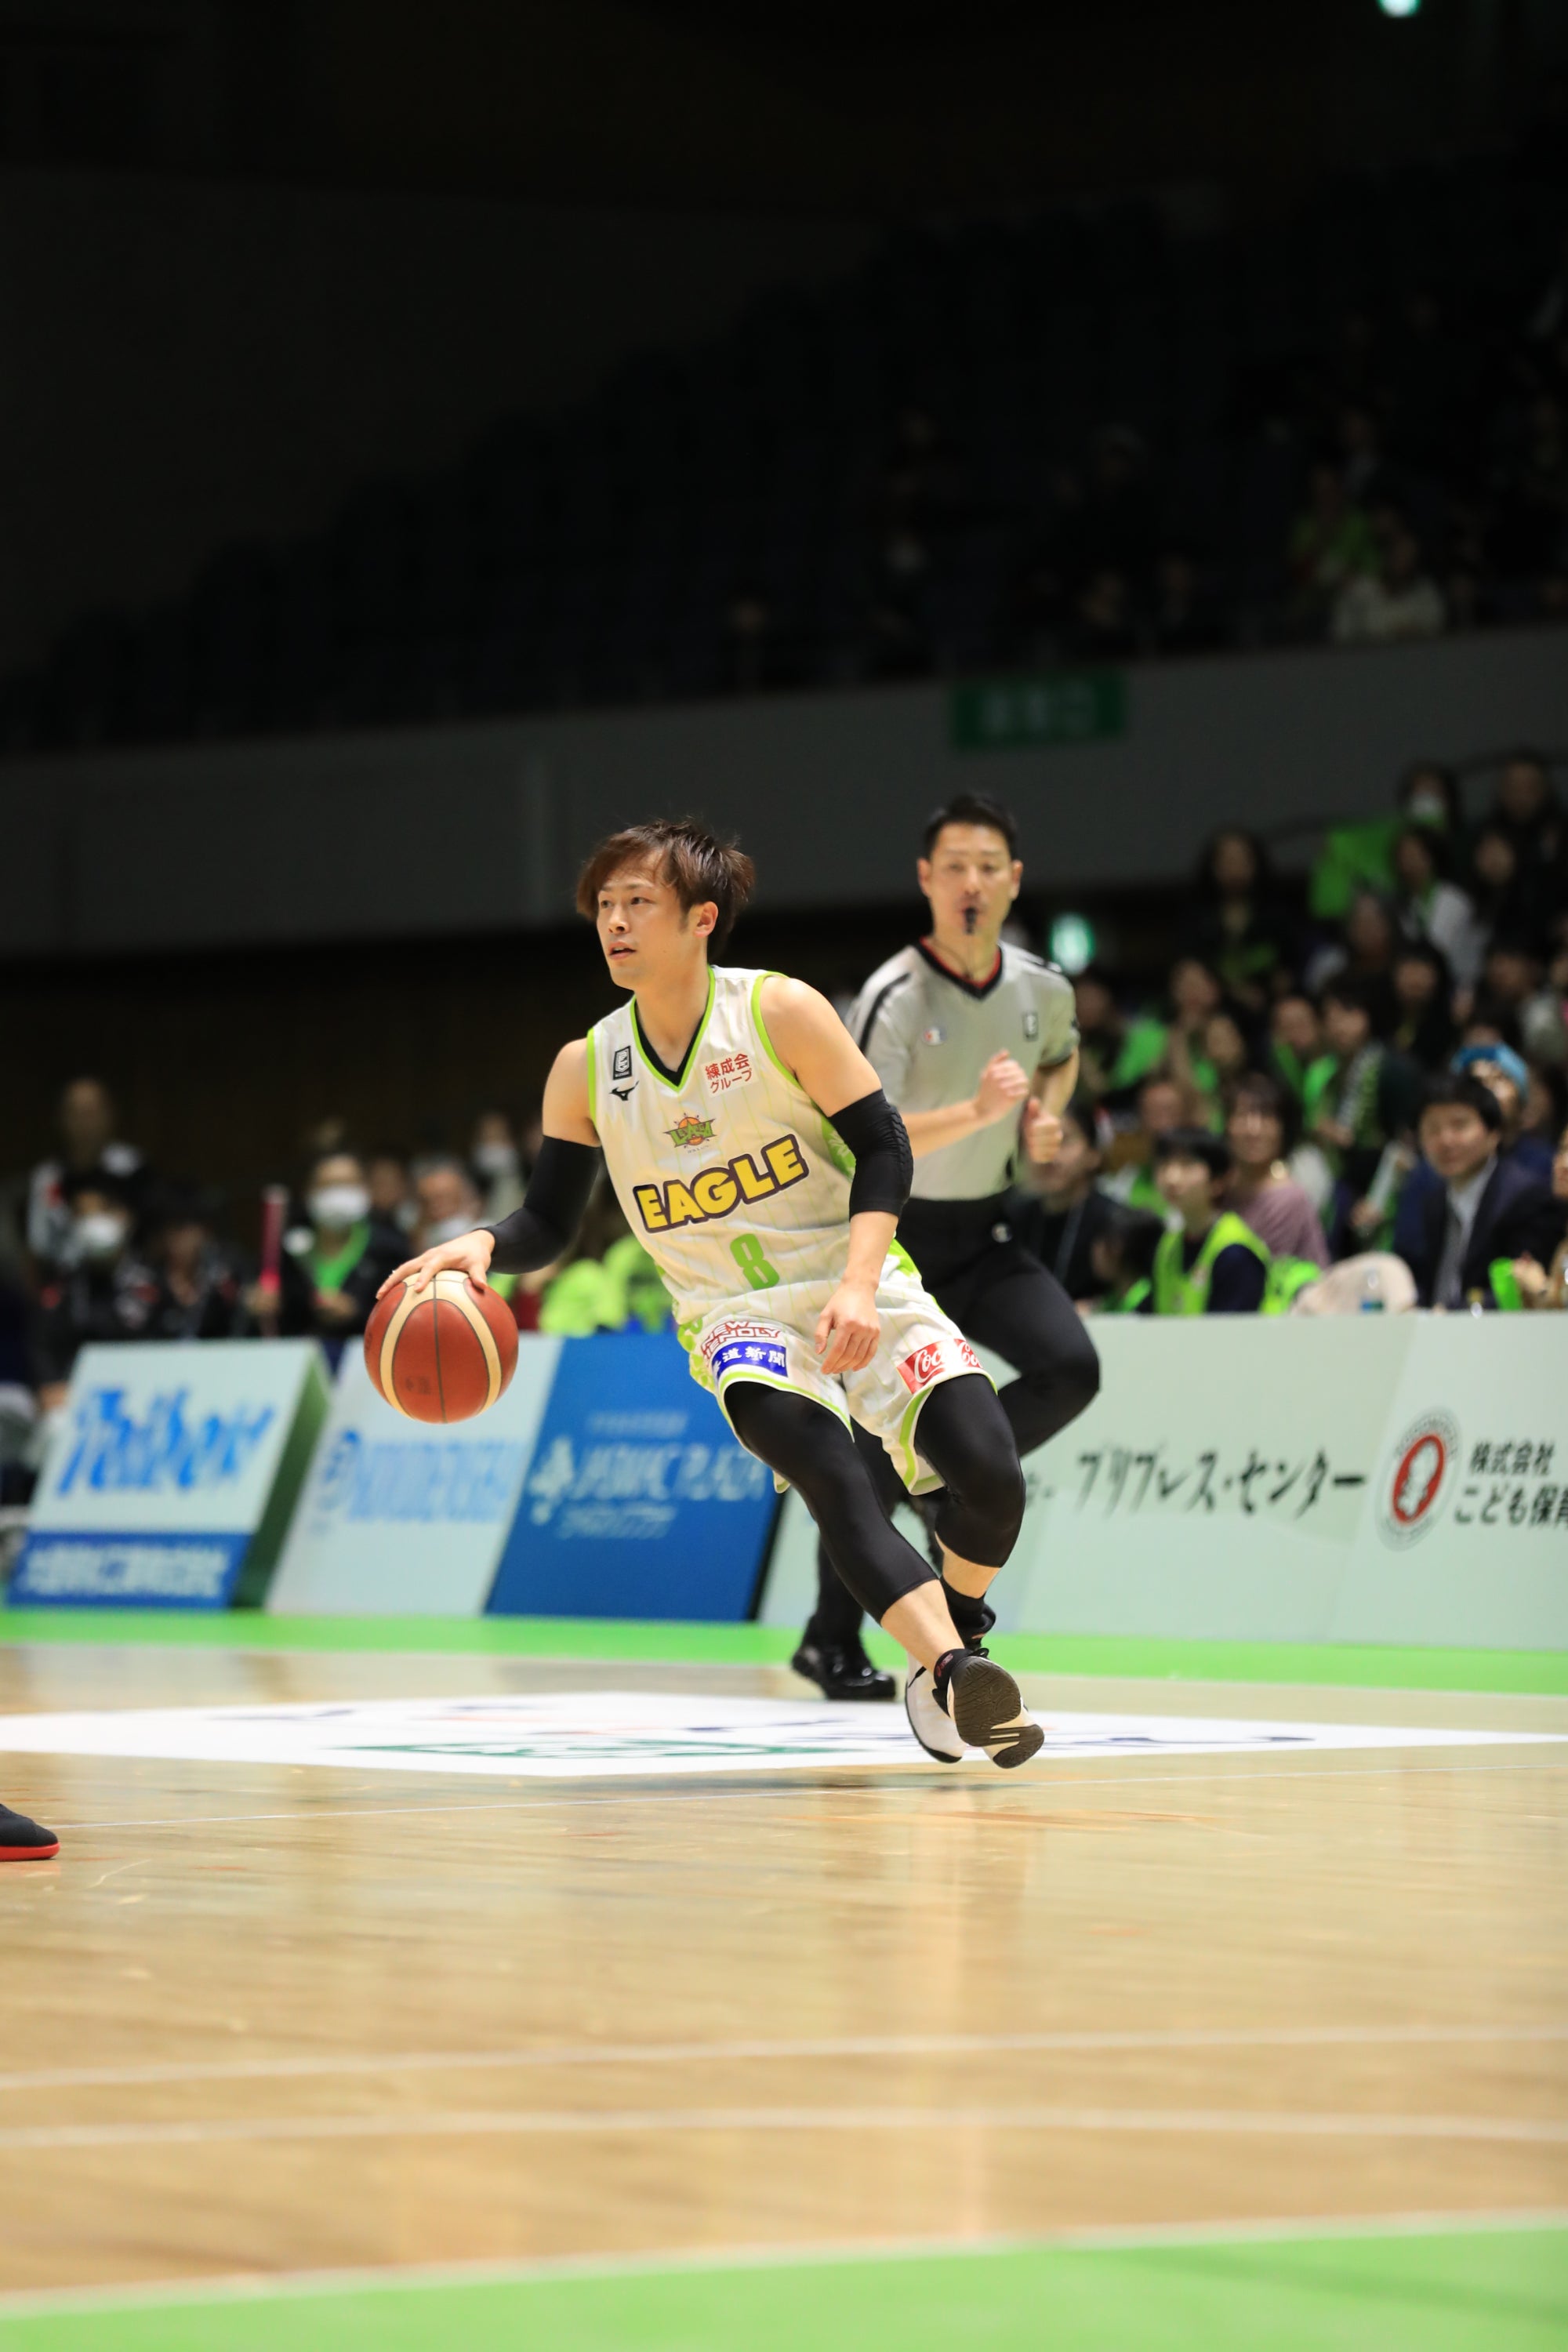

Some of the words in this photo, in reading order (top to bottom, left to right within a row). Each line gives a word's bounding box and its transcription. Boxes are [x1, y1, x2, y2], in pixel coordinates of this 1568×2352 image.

[705, 1053, 750, 1080] 練成会
[710, 1068, 753, 1094] グループ
[633, 1134, 810, 1233] EAGLE
[730, 1233, 779, 1290] 8
